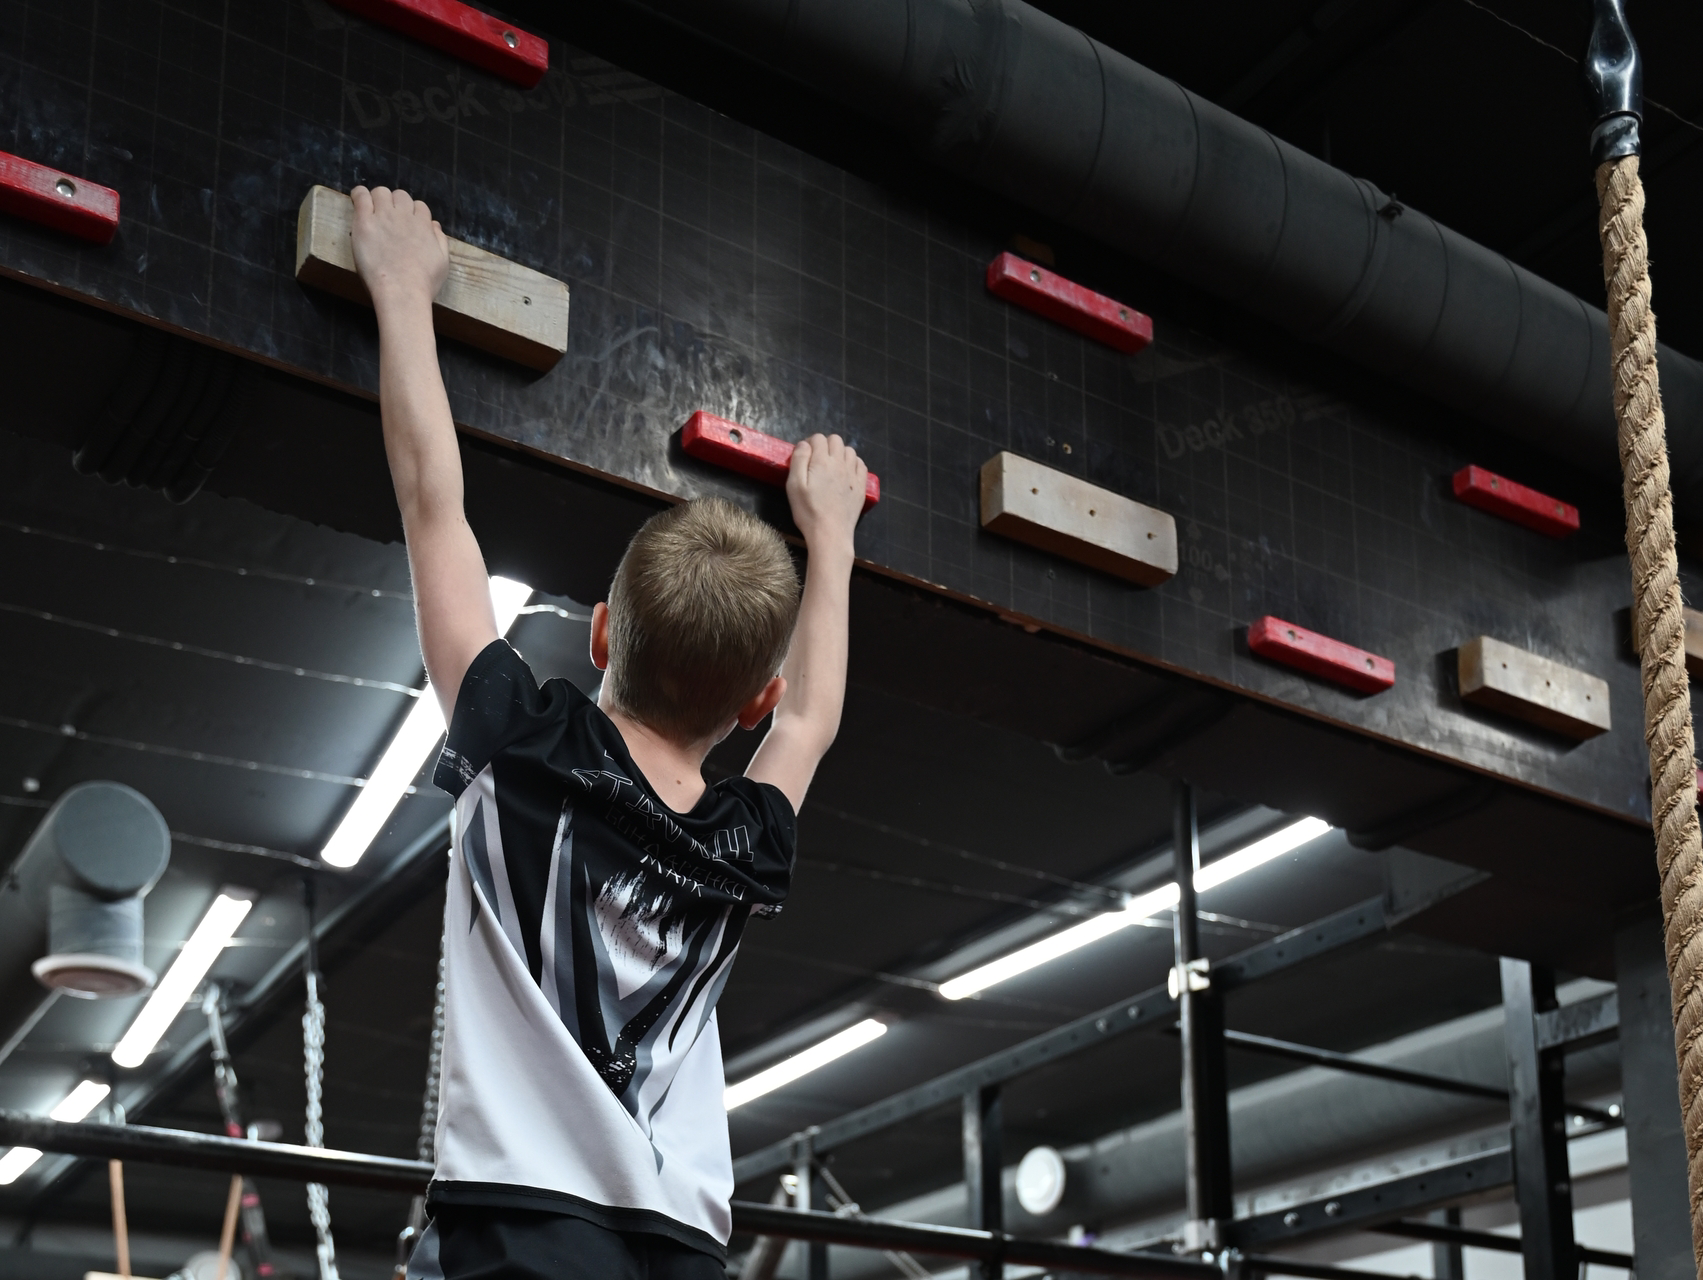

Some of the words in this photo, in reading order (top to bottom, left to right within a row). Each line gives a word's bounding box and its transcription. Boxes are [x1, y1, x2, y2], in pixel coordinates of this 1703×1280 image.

[344, 73, 489, 128] Deck
[1156, 408, 1244, 460] Deck
[1242, 395, 1296, 435] 350
